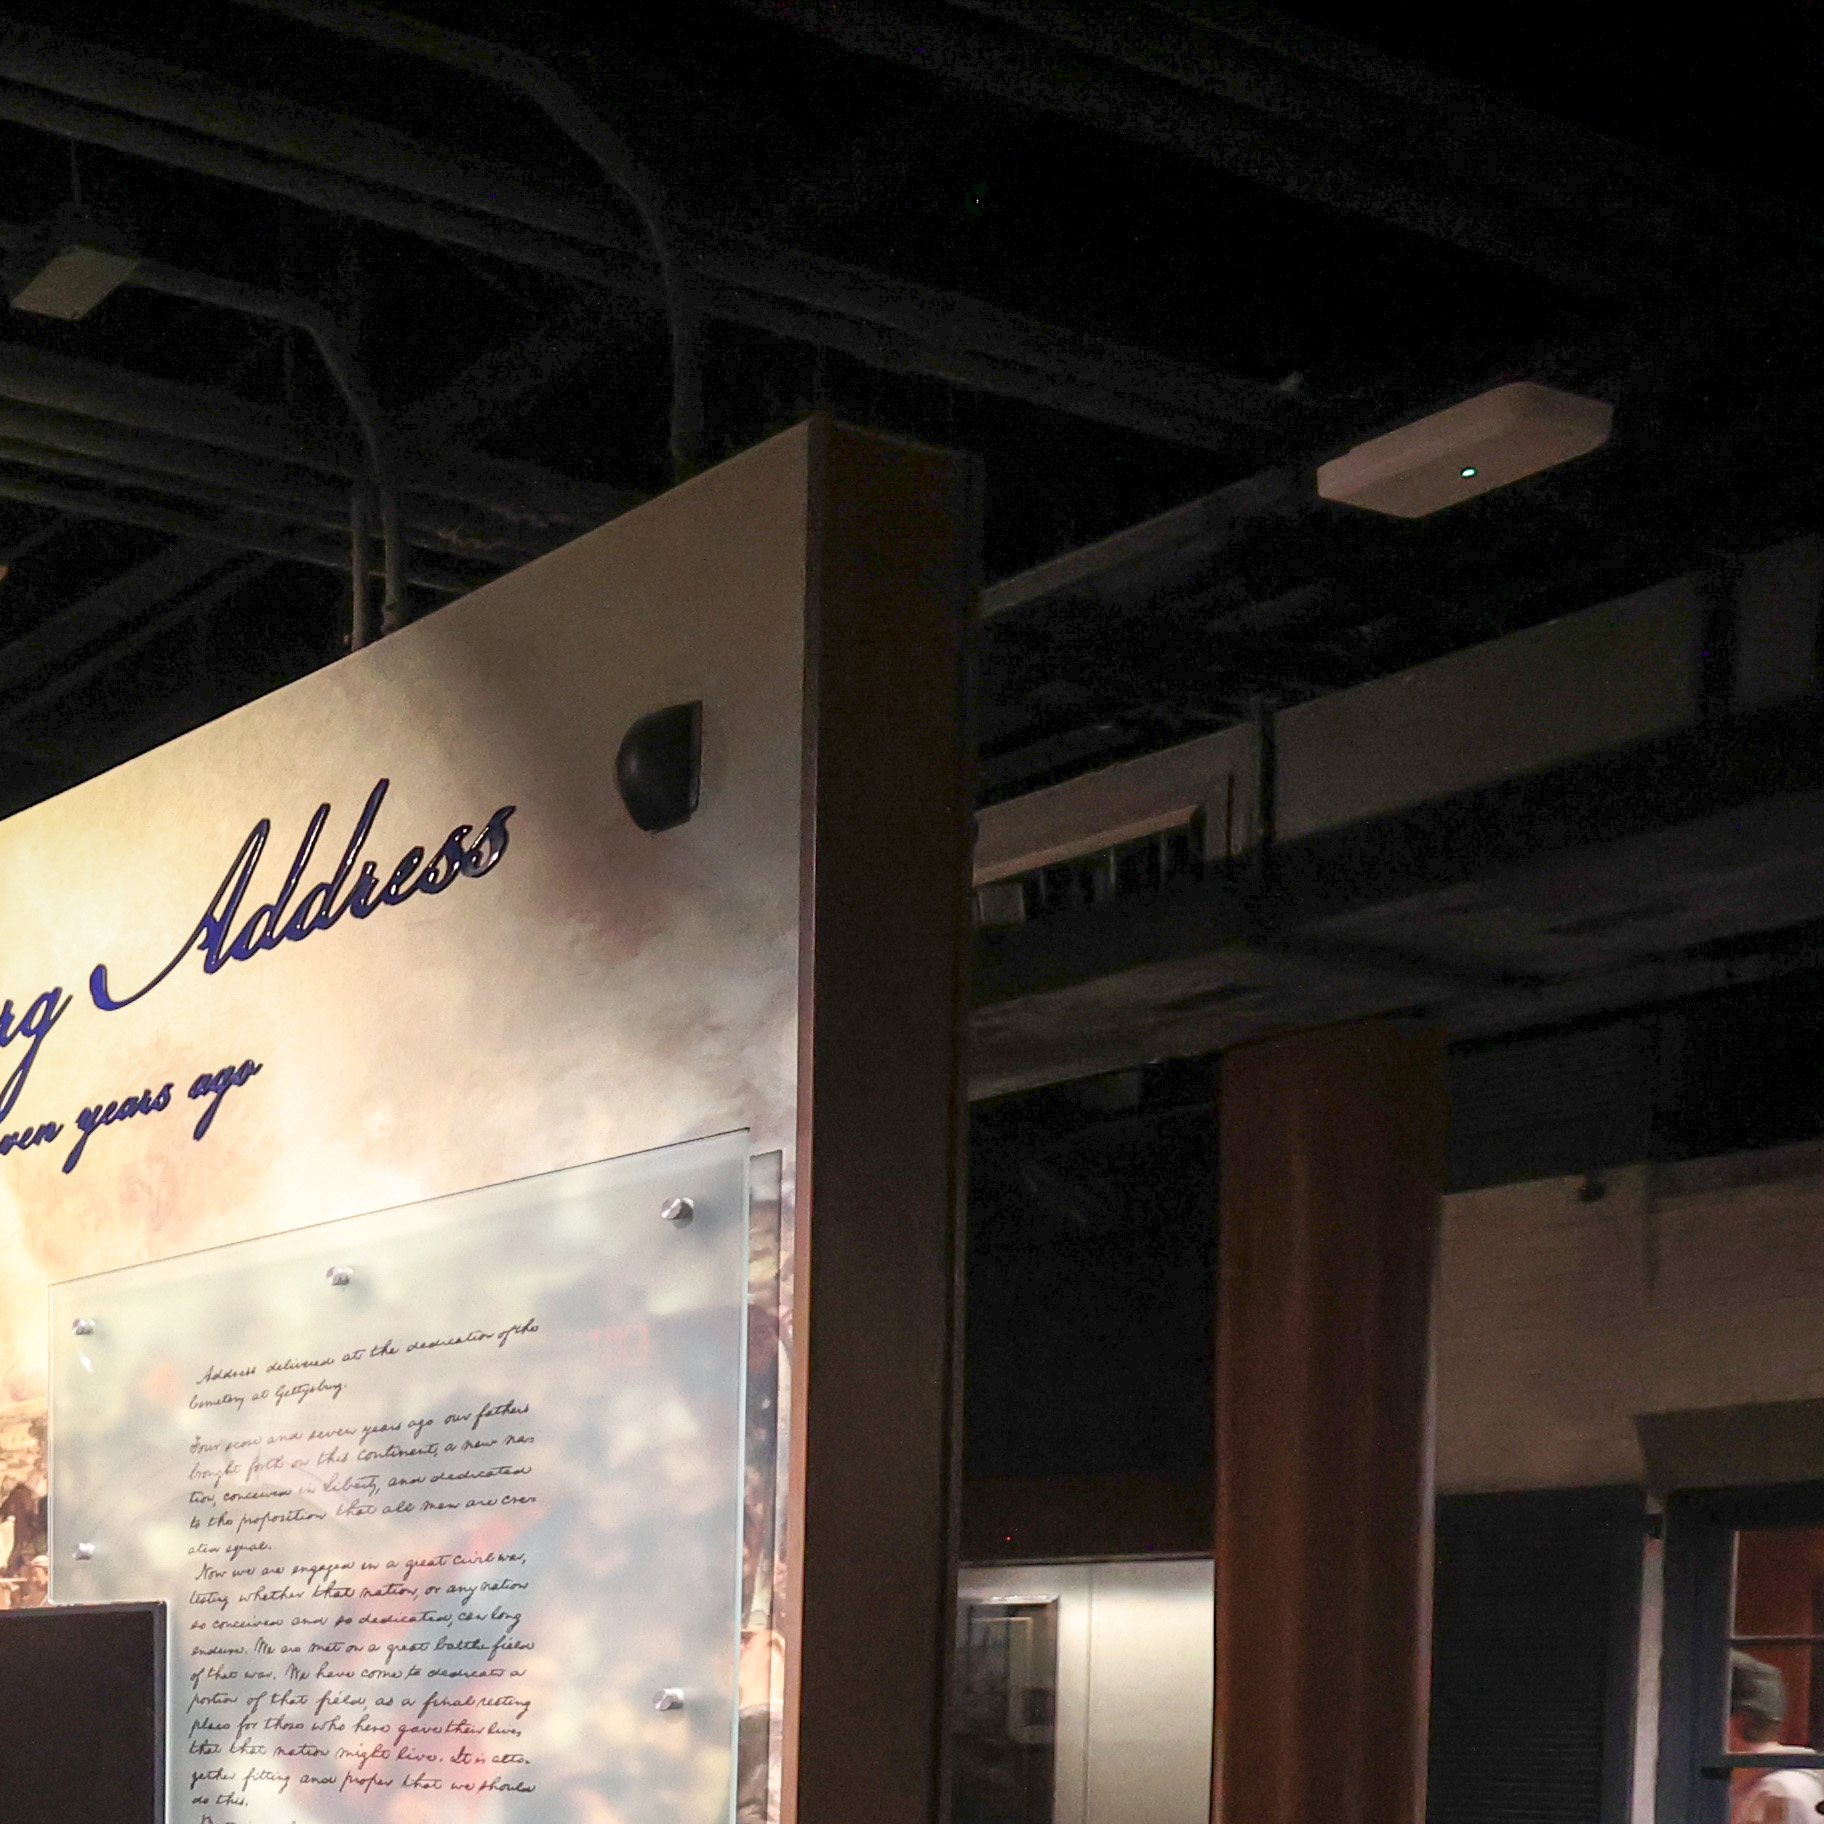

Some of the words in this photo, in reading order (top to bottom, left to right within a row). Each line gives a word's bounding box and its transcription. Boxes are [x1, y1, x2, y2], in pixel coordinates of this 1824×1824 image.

[90, 779, 515, 1010] Address
[64, 1084, 173, 1174] years
[189, 1059, 263, 1141] ago
[196, 1363, 257, 1385] Address
[266, 1354, 336, 1376] delivered
[343, 1349, 362, 1362] at
[370, 1339, 399, 1358] the
[407, 1331, 494, 1353] dedication
[511, 1318, 540, 1334] the
[252, 1390, 269, 1400] at
[190, 1435, 221, 1454] Four
[226, 1436, 262, 1451] score
[266, 1432, 303, 1444] and
[308, 1427, 357, 1441] seven
[362, 1421, 401, 1442] years
[408, 1418, 434, 1433] ago
[445, 1412, 472, 1424] our
[472, 1400, 530, 1430] fathers
[189, 1463, 241, 1481] brought
[246, 1457, 284, 1482] forth
[291, 1457, 309, 1466] on
[317, 1450, 349, 1465] this
[461, 1437, 497, 1449] new
[223, 1489, 291, 1502] conceived
[300, 1486, 315, 1494] in
[388, 1475, 426, 1488] and
[430, 1465, 533, 1483] dedicated
[190, 1517, 201, 1529] to
[208, 1514, 233, 1528] the
[236, 1509, 326, 1533] proposition
[336, 1500, 377, 1518] that
[382, 1500, 414, 1514] all
[420, 1502, 460, 1511] men
[465, 1497, 497, 1506] are
[187, 1545, 220, 1554] ated
[196, 1563, 228, 1581] Now
[232, 1567, 255, 1577] we
[262, 1566, 284, 1575] are
[292, 1562, 354, 1583] engaged
[361, 1562, 378, 1572] in
[405, 1555, 451, 1579] great
[453, 1552, 497, 1565] civil
[189, 1590, 228, 1611] testing
[239, 1585, 304, 1604] whether
[312, 1582, 355, 1599] that
[424, 1586, 441, 1596] or
[447, 1585, 478, 1605] any
[480, 1580, 528, 1592] nation
[190, 1621, 206, 1631] so
[212, 1618, 283, 1629] conceived
[291, 1616, 328, 1626] and
[334, 1615, 353, 1628] so
[458, 1612, 487, 1621] can
[491, 1606, 522, 1631] long
[255, 1635, 276, 1654] We
[280, 1645, 301, 1654] are
[308, 1641, 345, 1653] met
[347, 1642, 366, 1653] on
[368, 1643, 380, 1652] a
[386, 1642, 430, 1663] great
[488, 1637, 535, 1660] field
[190, 1666, 205, 1688] of
[208, 1666, 238, 1680] that
[286, 1663, 309, 1681] We
[316, 1663, 354, 1678] have
[361, 1669, 403, 1680] come
[404, 1661, 421, 1678] to
[428, 1668, 503, 1678] dedicate
[510, 1669, 526, 1677] a
